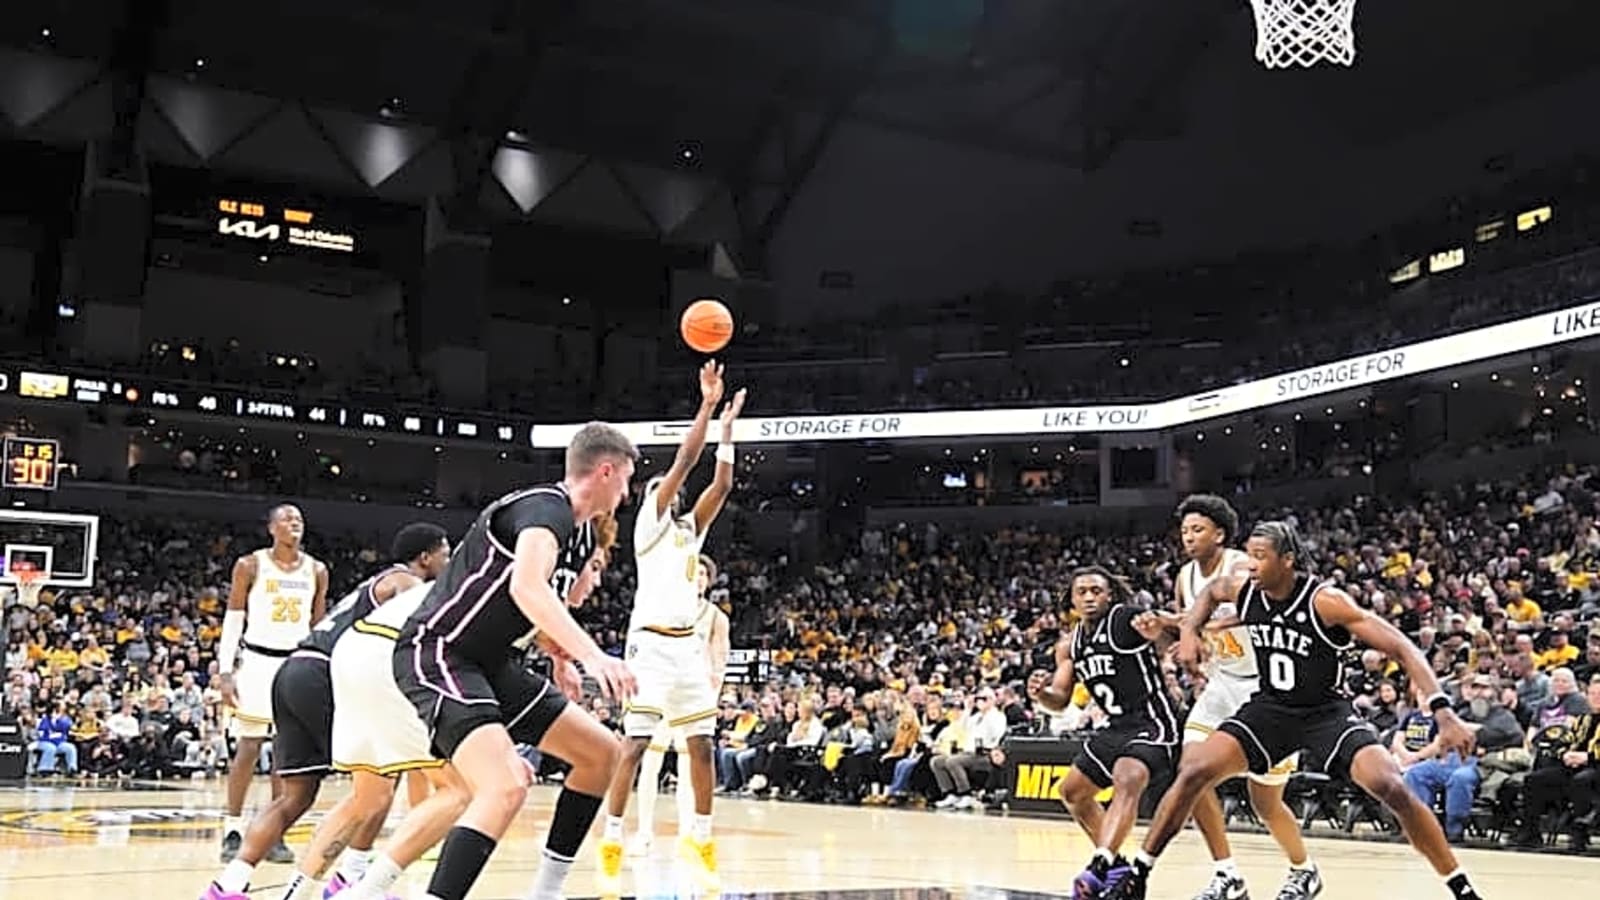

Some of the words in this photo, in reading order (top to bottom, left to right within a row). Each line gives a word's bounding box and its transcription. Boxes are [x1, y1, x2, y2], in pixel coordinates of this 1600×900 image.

[1553, 306, 1600, 335] LIKE
[1277, 363, 1361, 396] STORAGE
[1366, 352, 1405, 376] FOR
[760, 420, 854, 436] STORAGE
[859, 417, 901, 433] FOR
[1043, 411, 1087, 427] LIKE
[1096, 409, 1148, 425] YOU!
[13, 458, 47, 484] 30
[271, 597, 302, 622] 25
[1248, 623, 1312, 657] STATE
[1075, 654, 1117, 683] TATE
[1269, 652, 1295, 691] 0
[1094, 683, 1123, 714] 2
